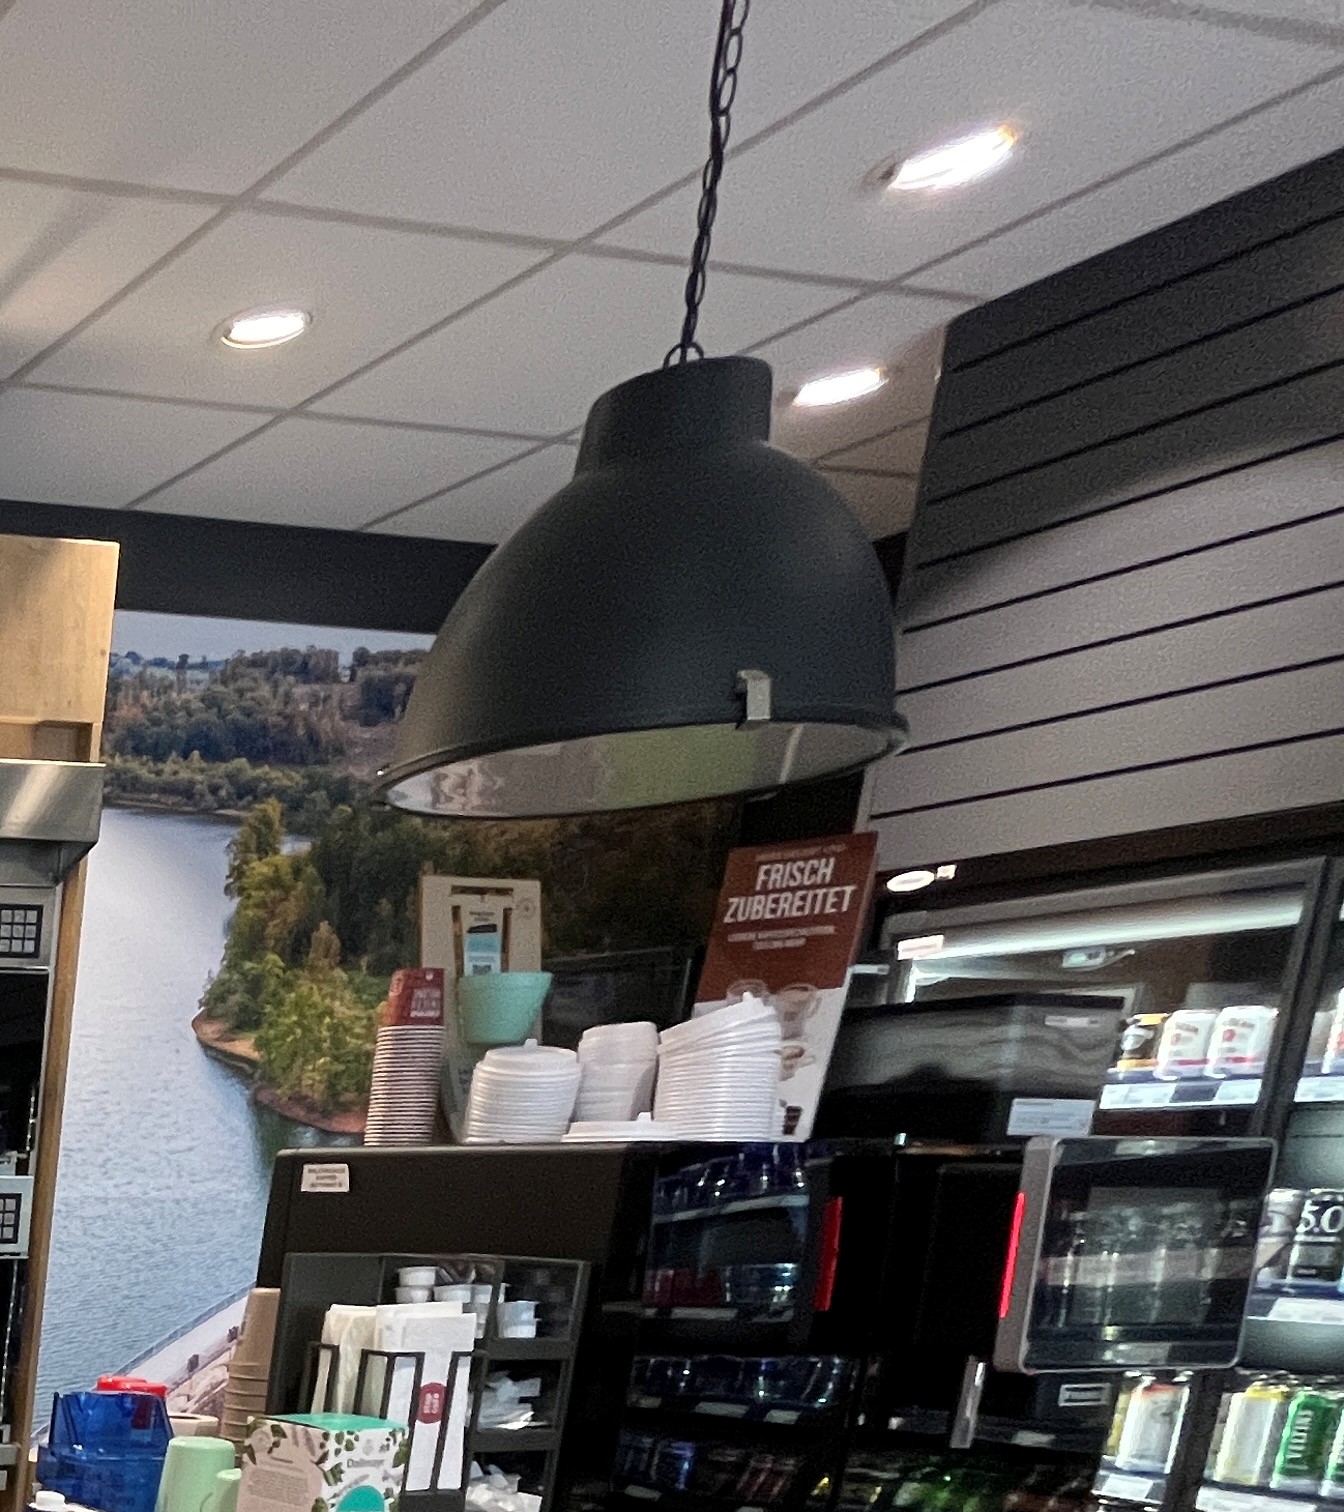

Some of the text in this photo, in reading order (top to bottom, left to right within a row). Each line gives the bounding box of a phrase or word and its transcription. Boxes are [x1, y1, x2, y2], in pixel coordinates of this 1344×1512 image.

[754, 856, 836, 892] FRISCH
[722, 883, 858, 924] ZUBEREITET
[1295, 1199, 1344, 1234] 5.0
